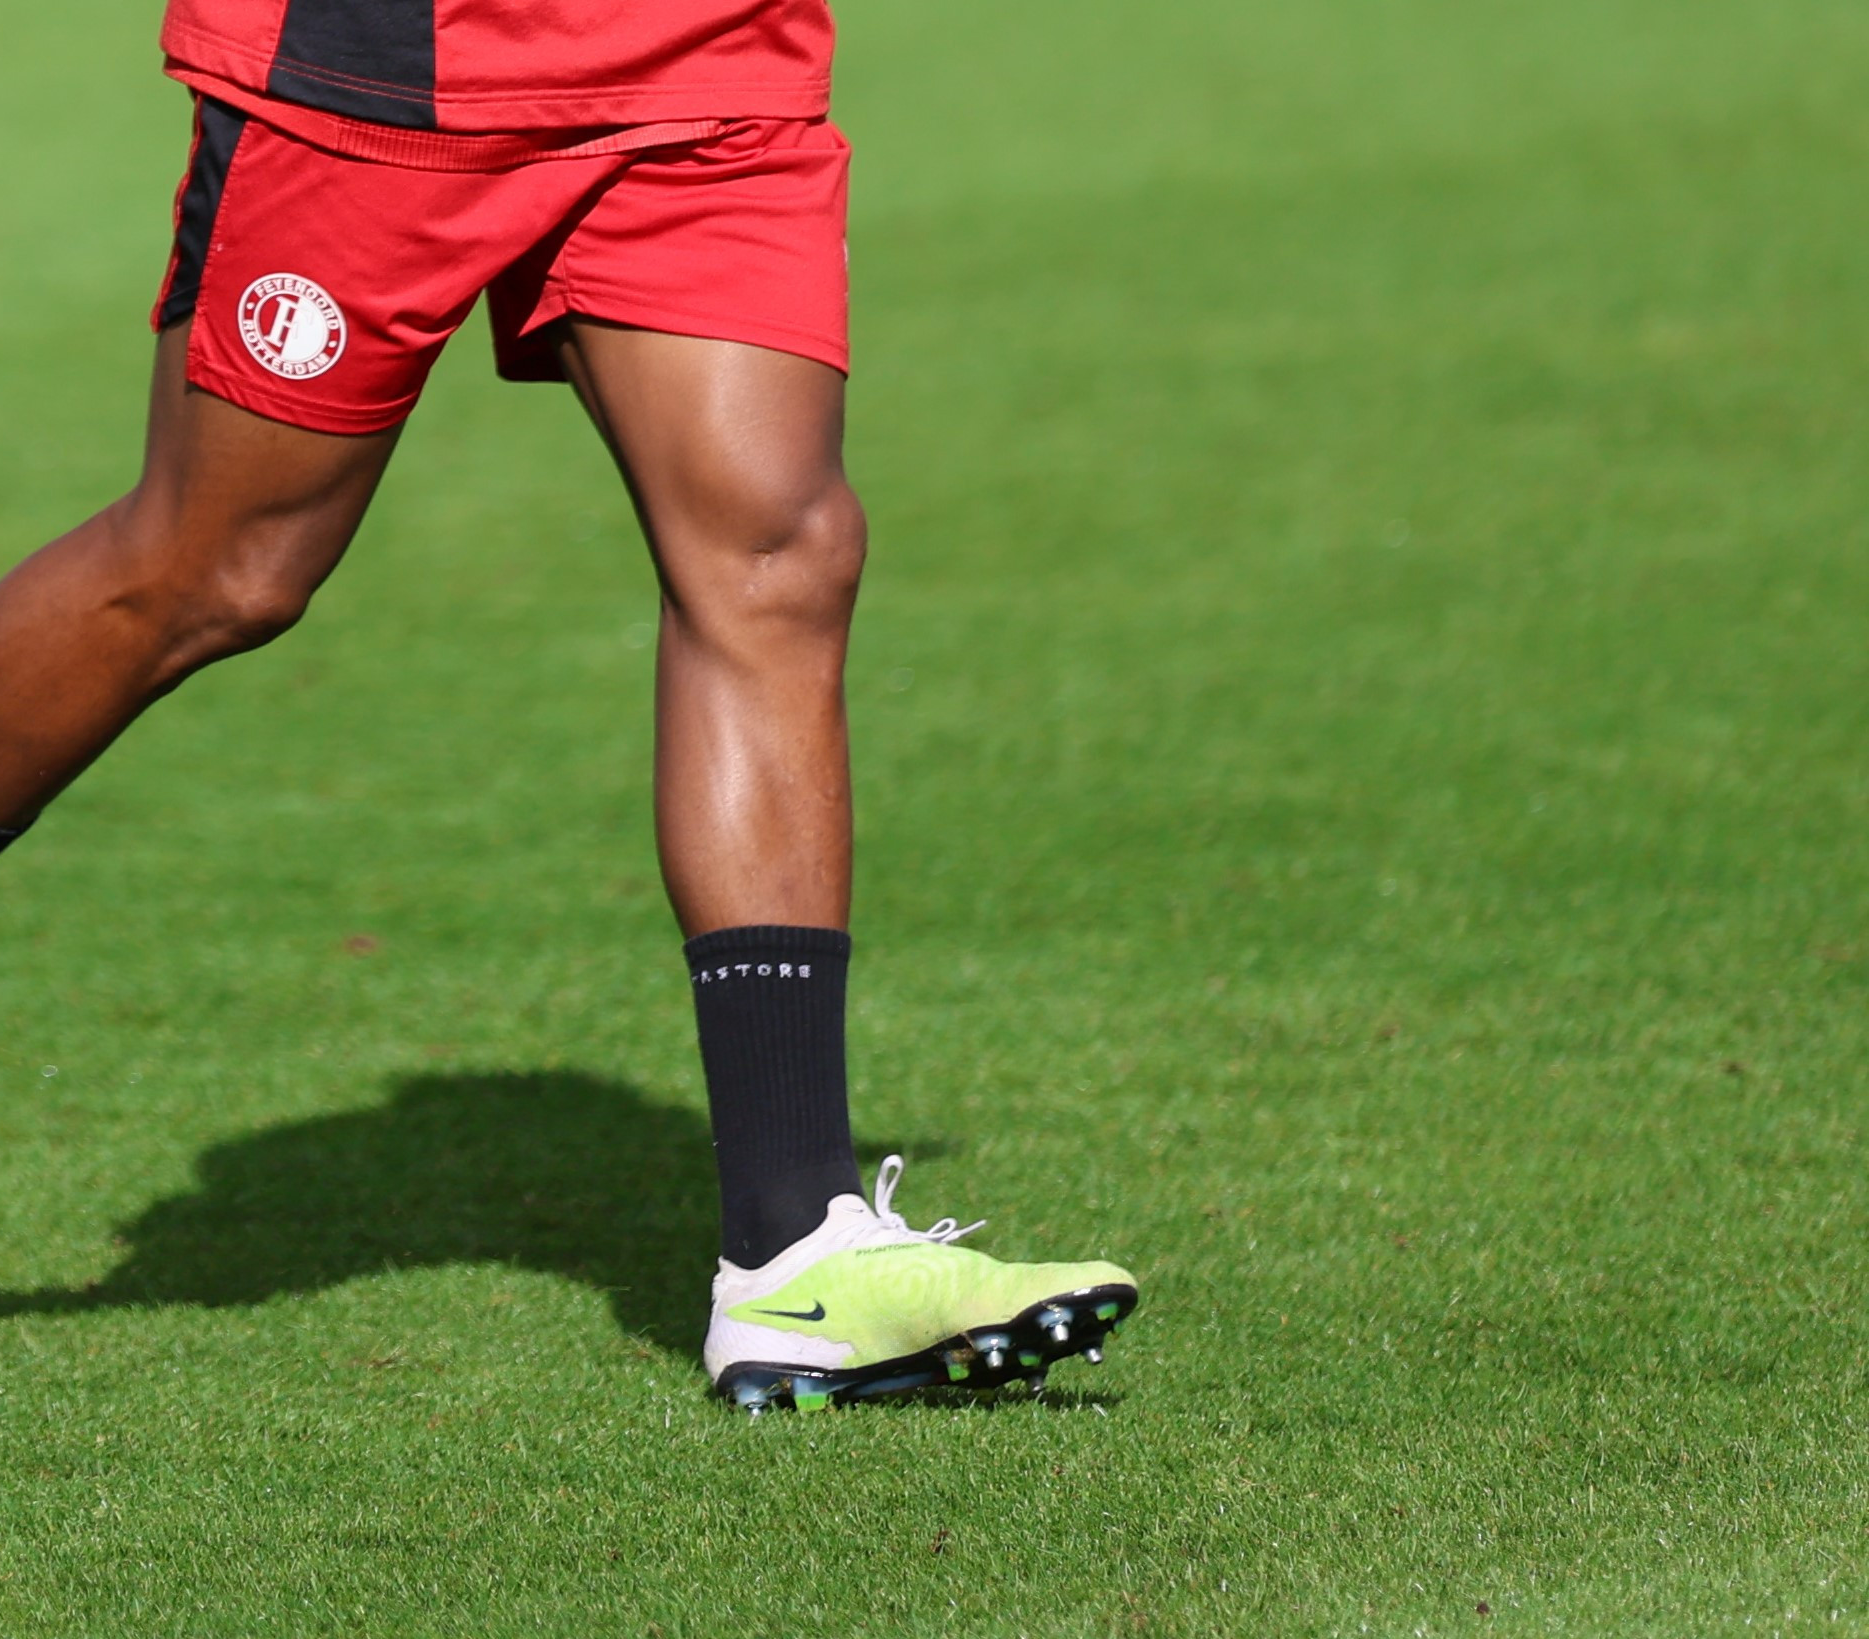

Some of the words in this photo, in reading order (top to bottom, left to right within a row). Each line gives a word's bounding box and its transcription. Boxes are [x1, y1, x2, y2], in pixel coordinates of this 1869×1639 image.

[253, 277, 341, 331] FEYENOORD
[242, 318, 331, 377] ROTTERDAM
[691, 962, 812, 985] ASTORE
